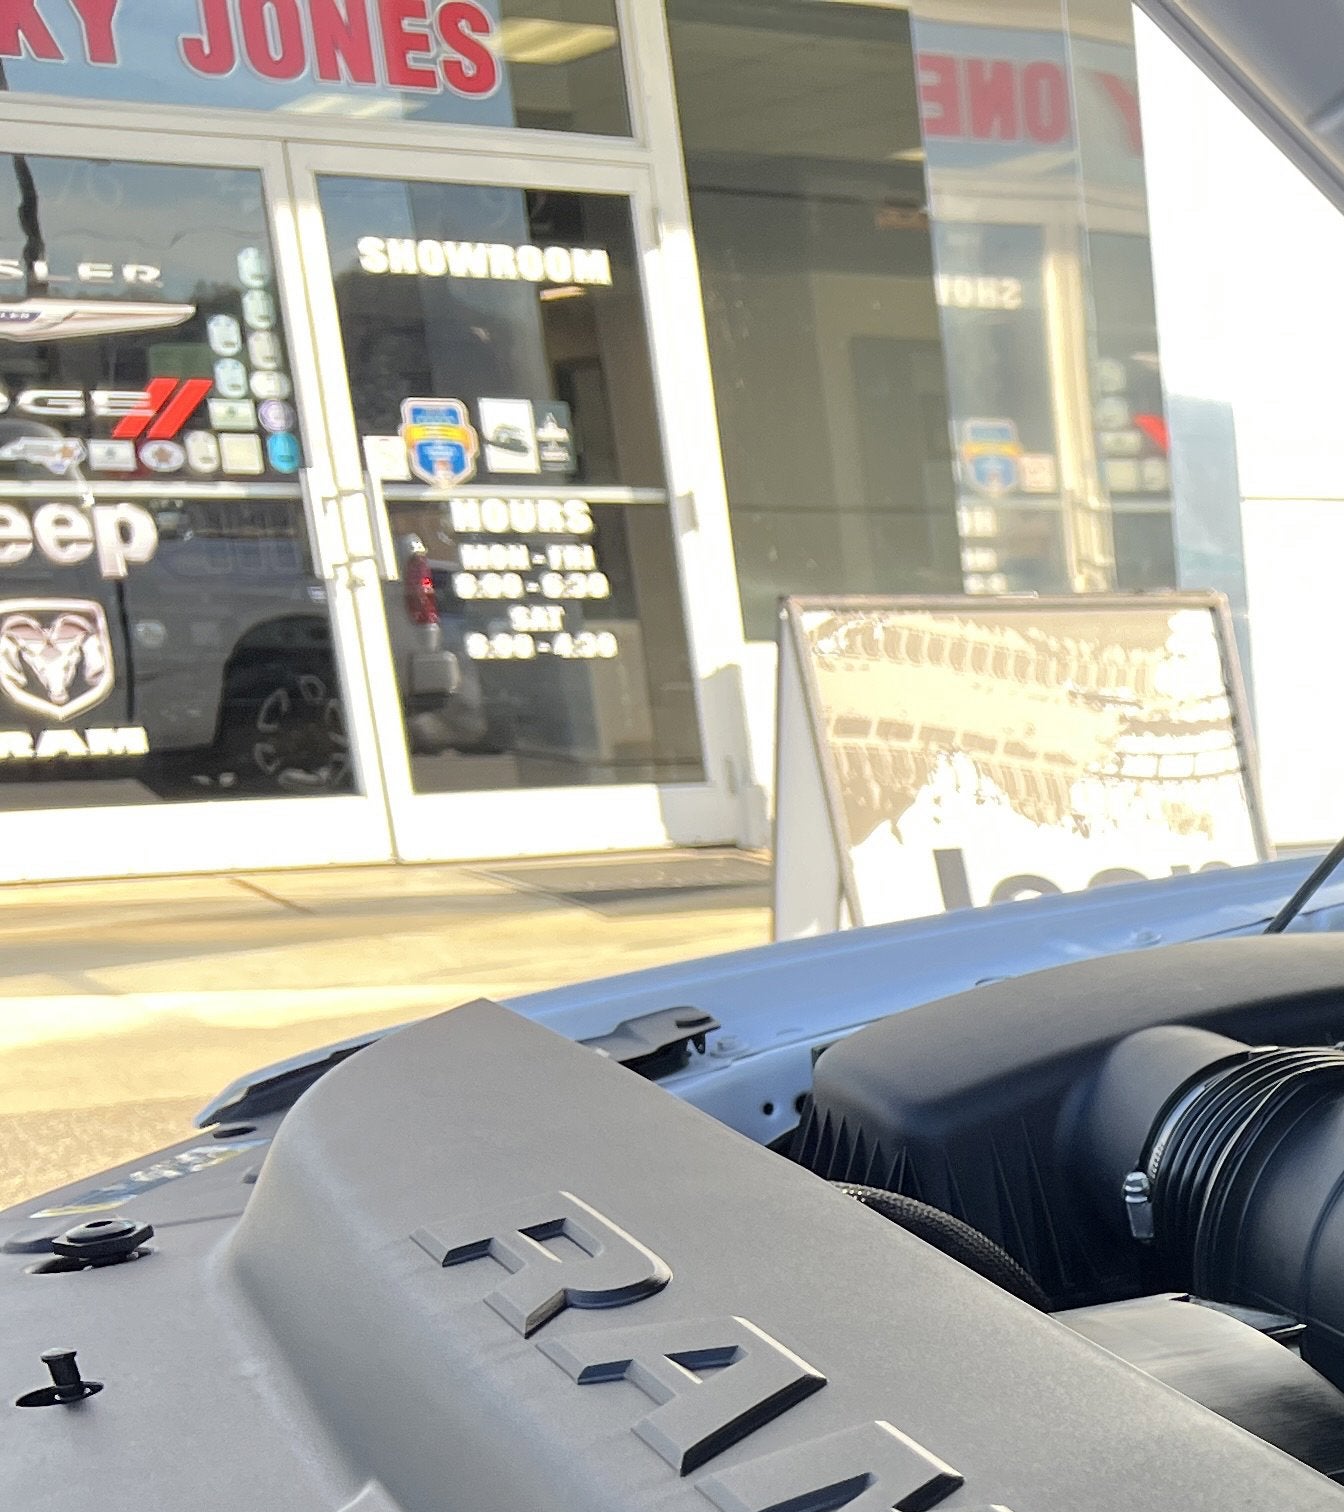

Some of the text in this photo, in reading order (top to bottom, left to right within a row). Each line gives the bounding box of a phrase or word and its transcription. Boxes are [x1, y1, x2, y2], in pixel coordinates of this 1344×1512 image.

[179, 0, 500, 98] JONES
[357, 236, 613, 287] SHOWROOM
[451, 498, 594, 534] HOURS
[461, 543, 531, 571] MON
[508, 604, 565, 632] SAT
